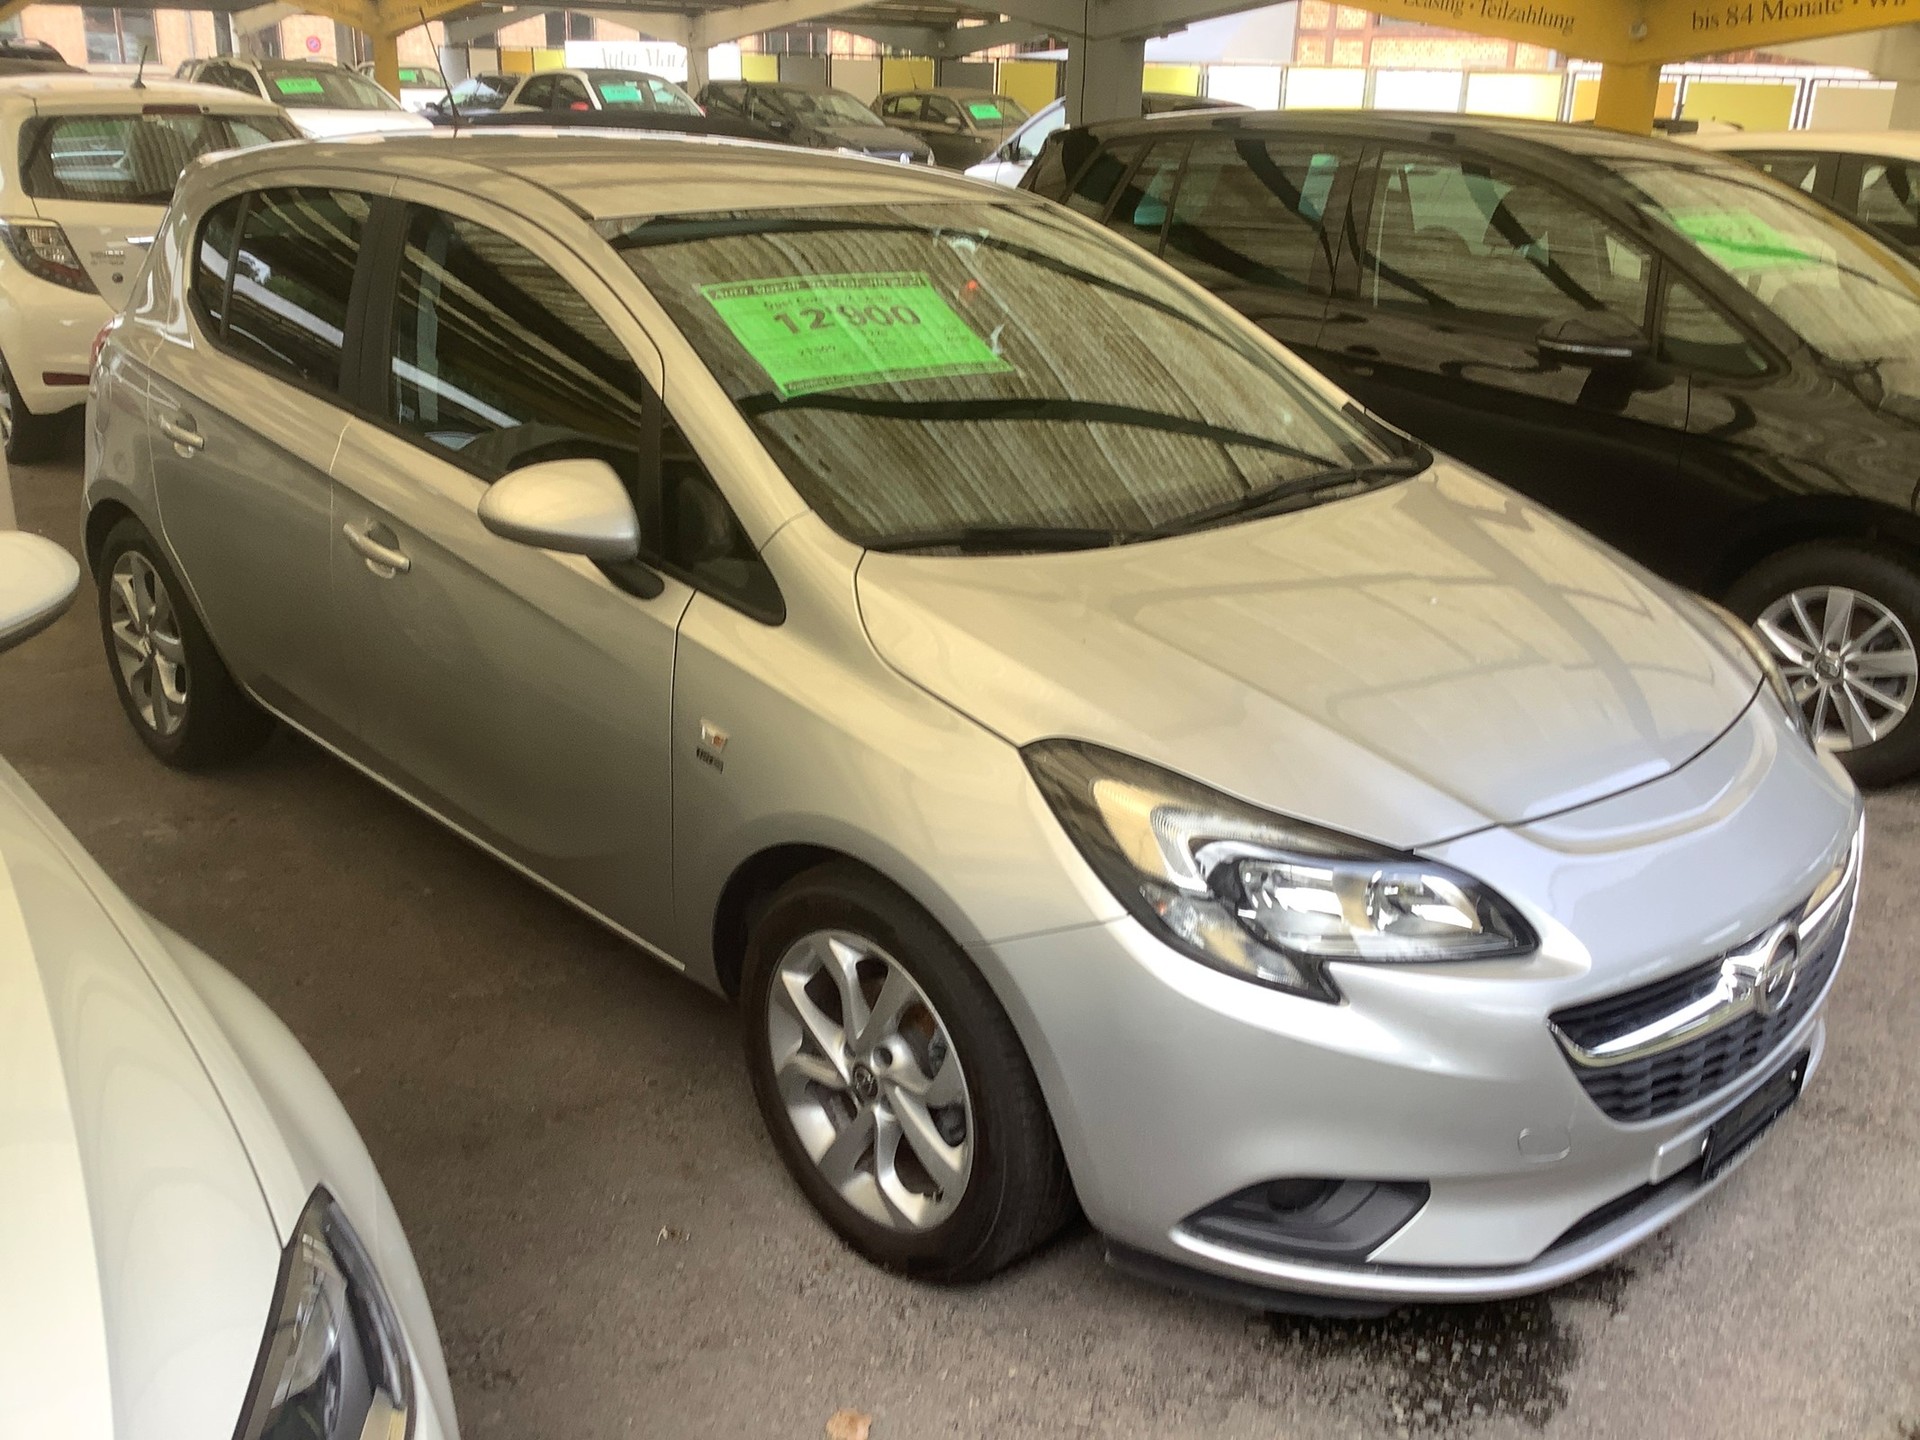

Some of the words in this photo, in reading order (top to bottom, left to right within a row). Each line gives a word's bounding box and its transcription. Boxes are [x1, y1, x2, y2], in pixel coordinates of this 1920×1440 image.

[1479, 0, 1575, 35] Teilzahlung
[1692, 10, 1720, 30] bis
[1726, 3, 1752, 26] 84
[1761, 0, 1843, 22] Monate
